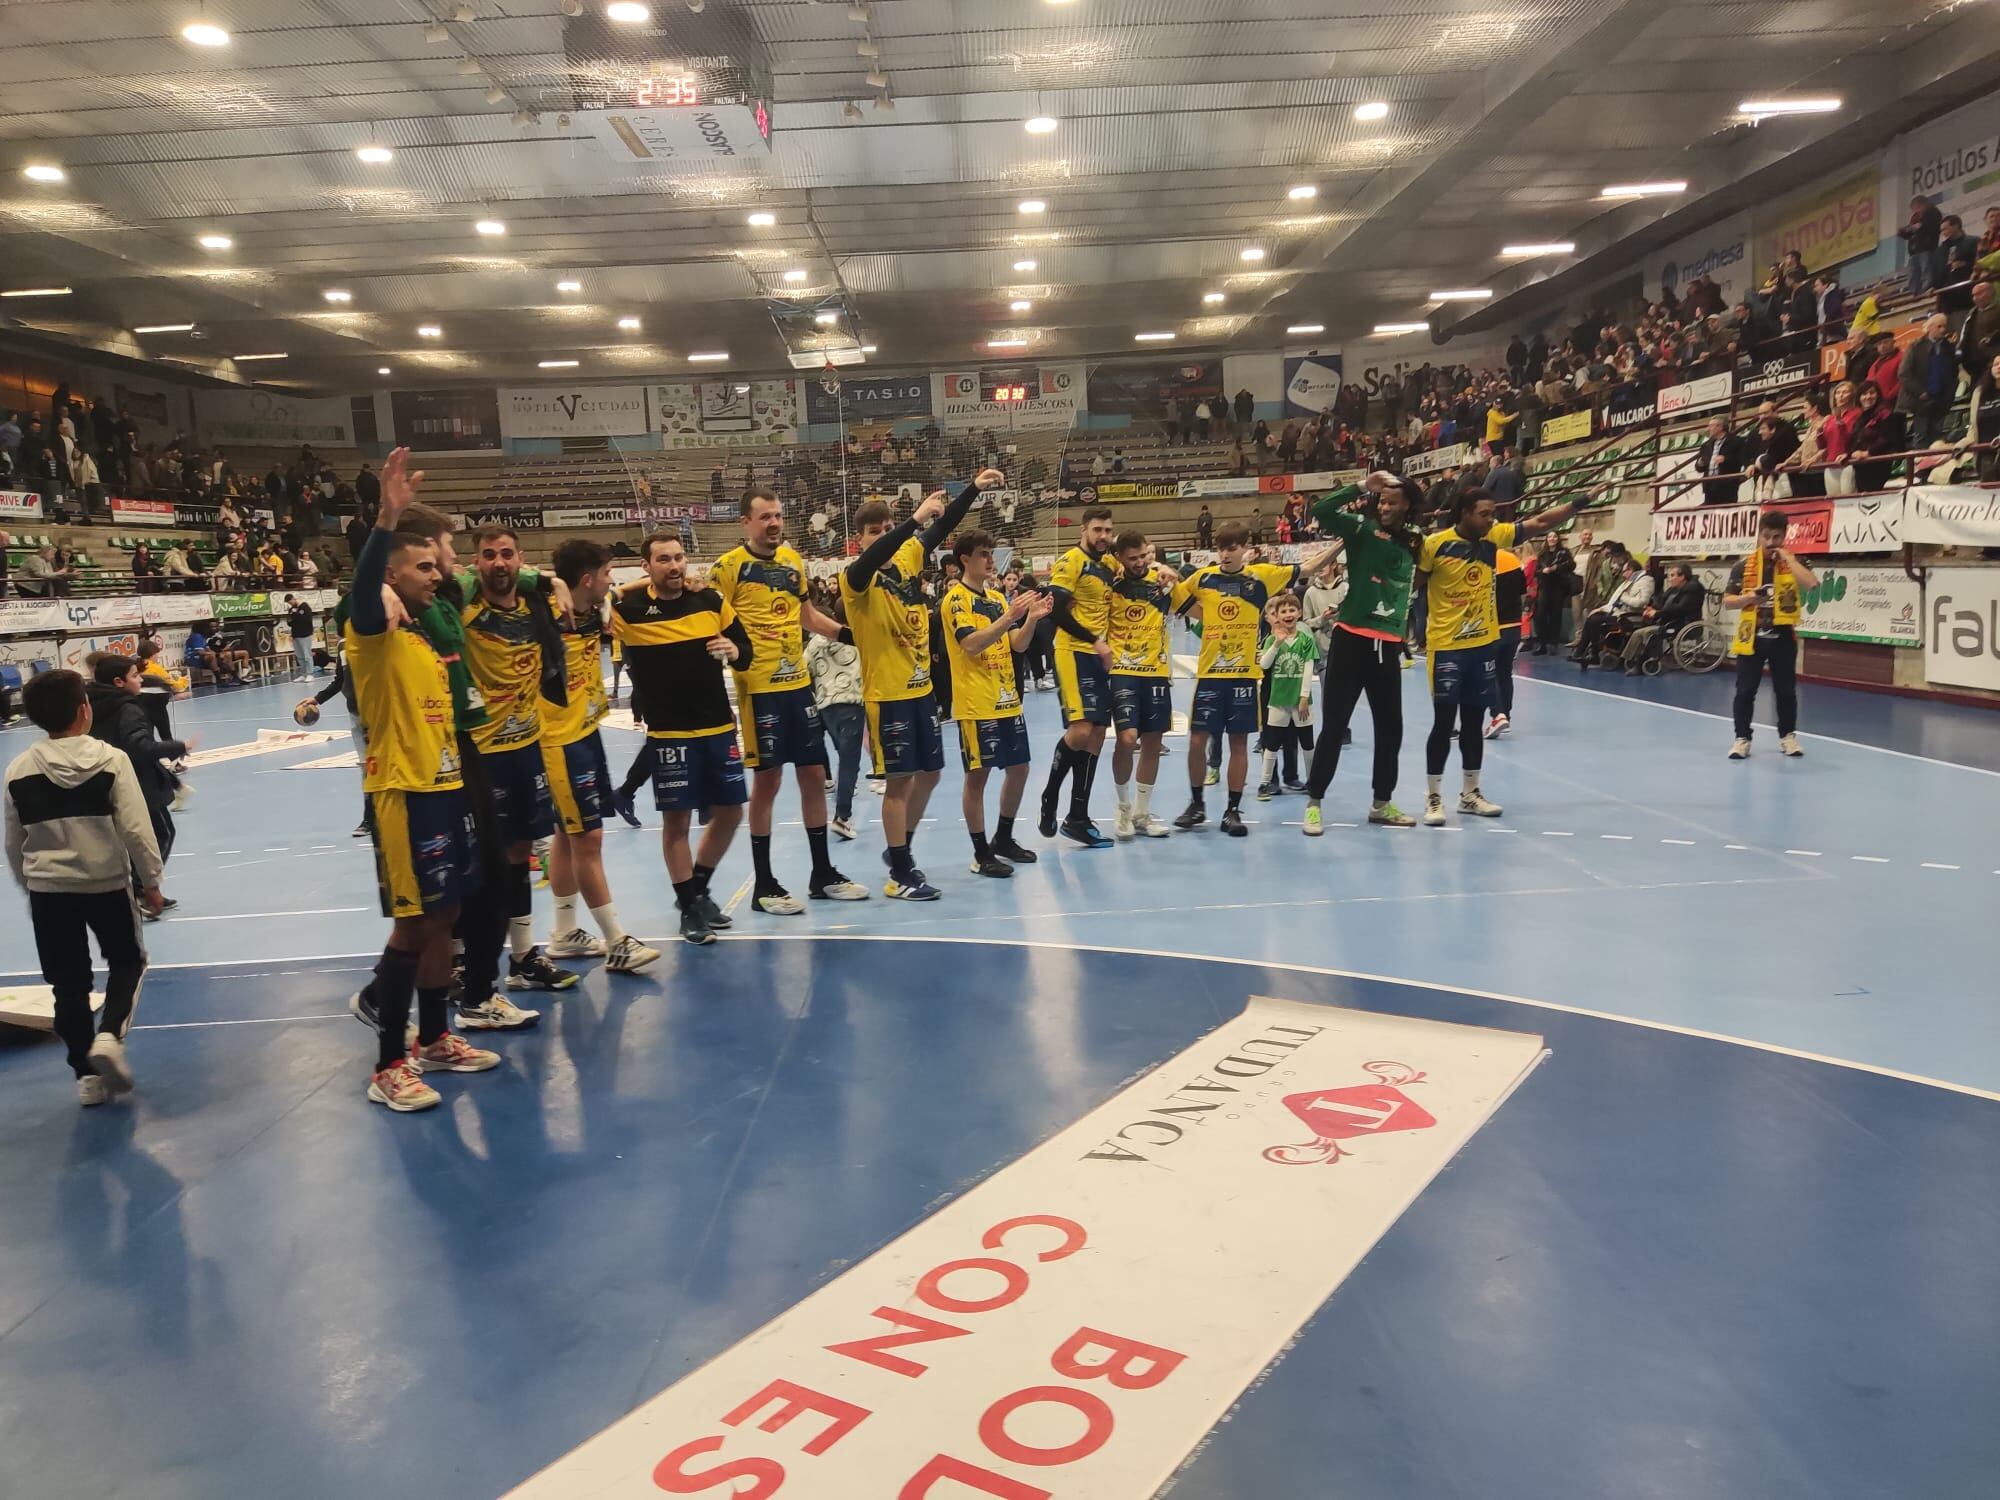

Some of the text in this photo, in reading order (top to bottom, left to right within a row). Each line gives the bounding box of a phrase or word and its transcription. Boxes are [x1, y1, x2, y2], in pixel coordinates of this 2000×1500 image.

[688, 56, 729, 69] VISITANTE
[583, 97, 735, 110] FALTAS FALTAS
[1911, 144, 1987, 196] Rótulos
[853, 386, 921, 400] TASIO
[512, 402, 560, 413] HOTEL
[580, 400, 640, 412] CIUDAD
[588, 510, 624, 522] NORTE
[1665, 510, 1758, 541] CASA SILVIANO
[1834, 519, 1898, 544] AJAX
[656, 746, 688, 765] TBT
[1077, 1024, 1327, 1163] TUDANCA
[1226, 1069, 1298, 1121] GRUPO
[1304, 1096, 1403, 1131] T
